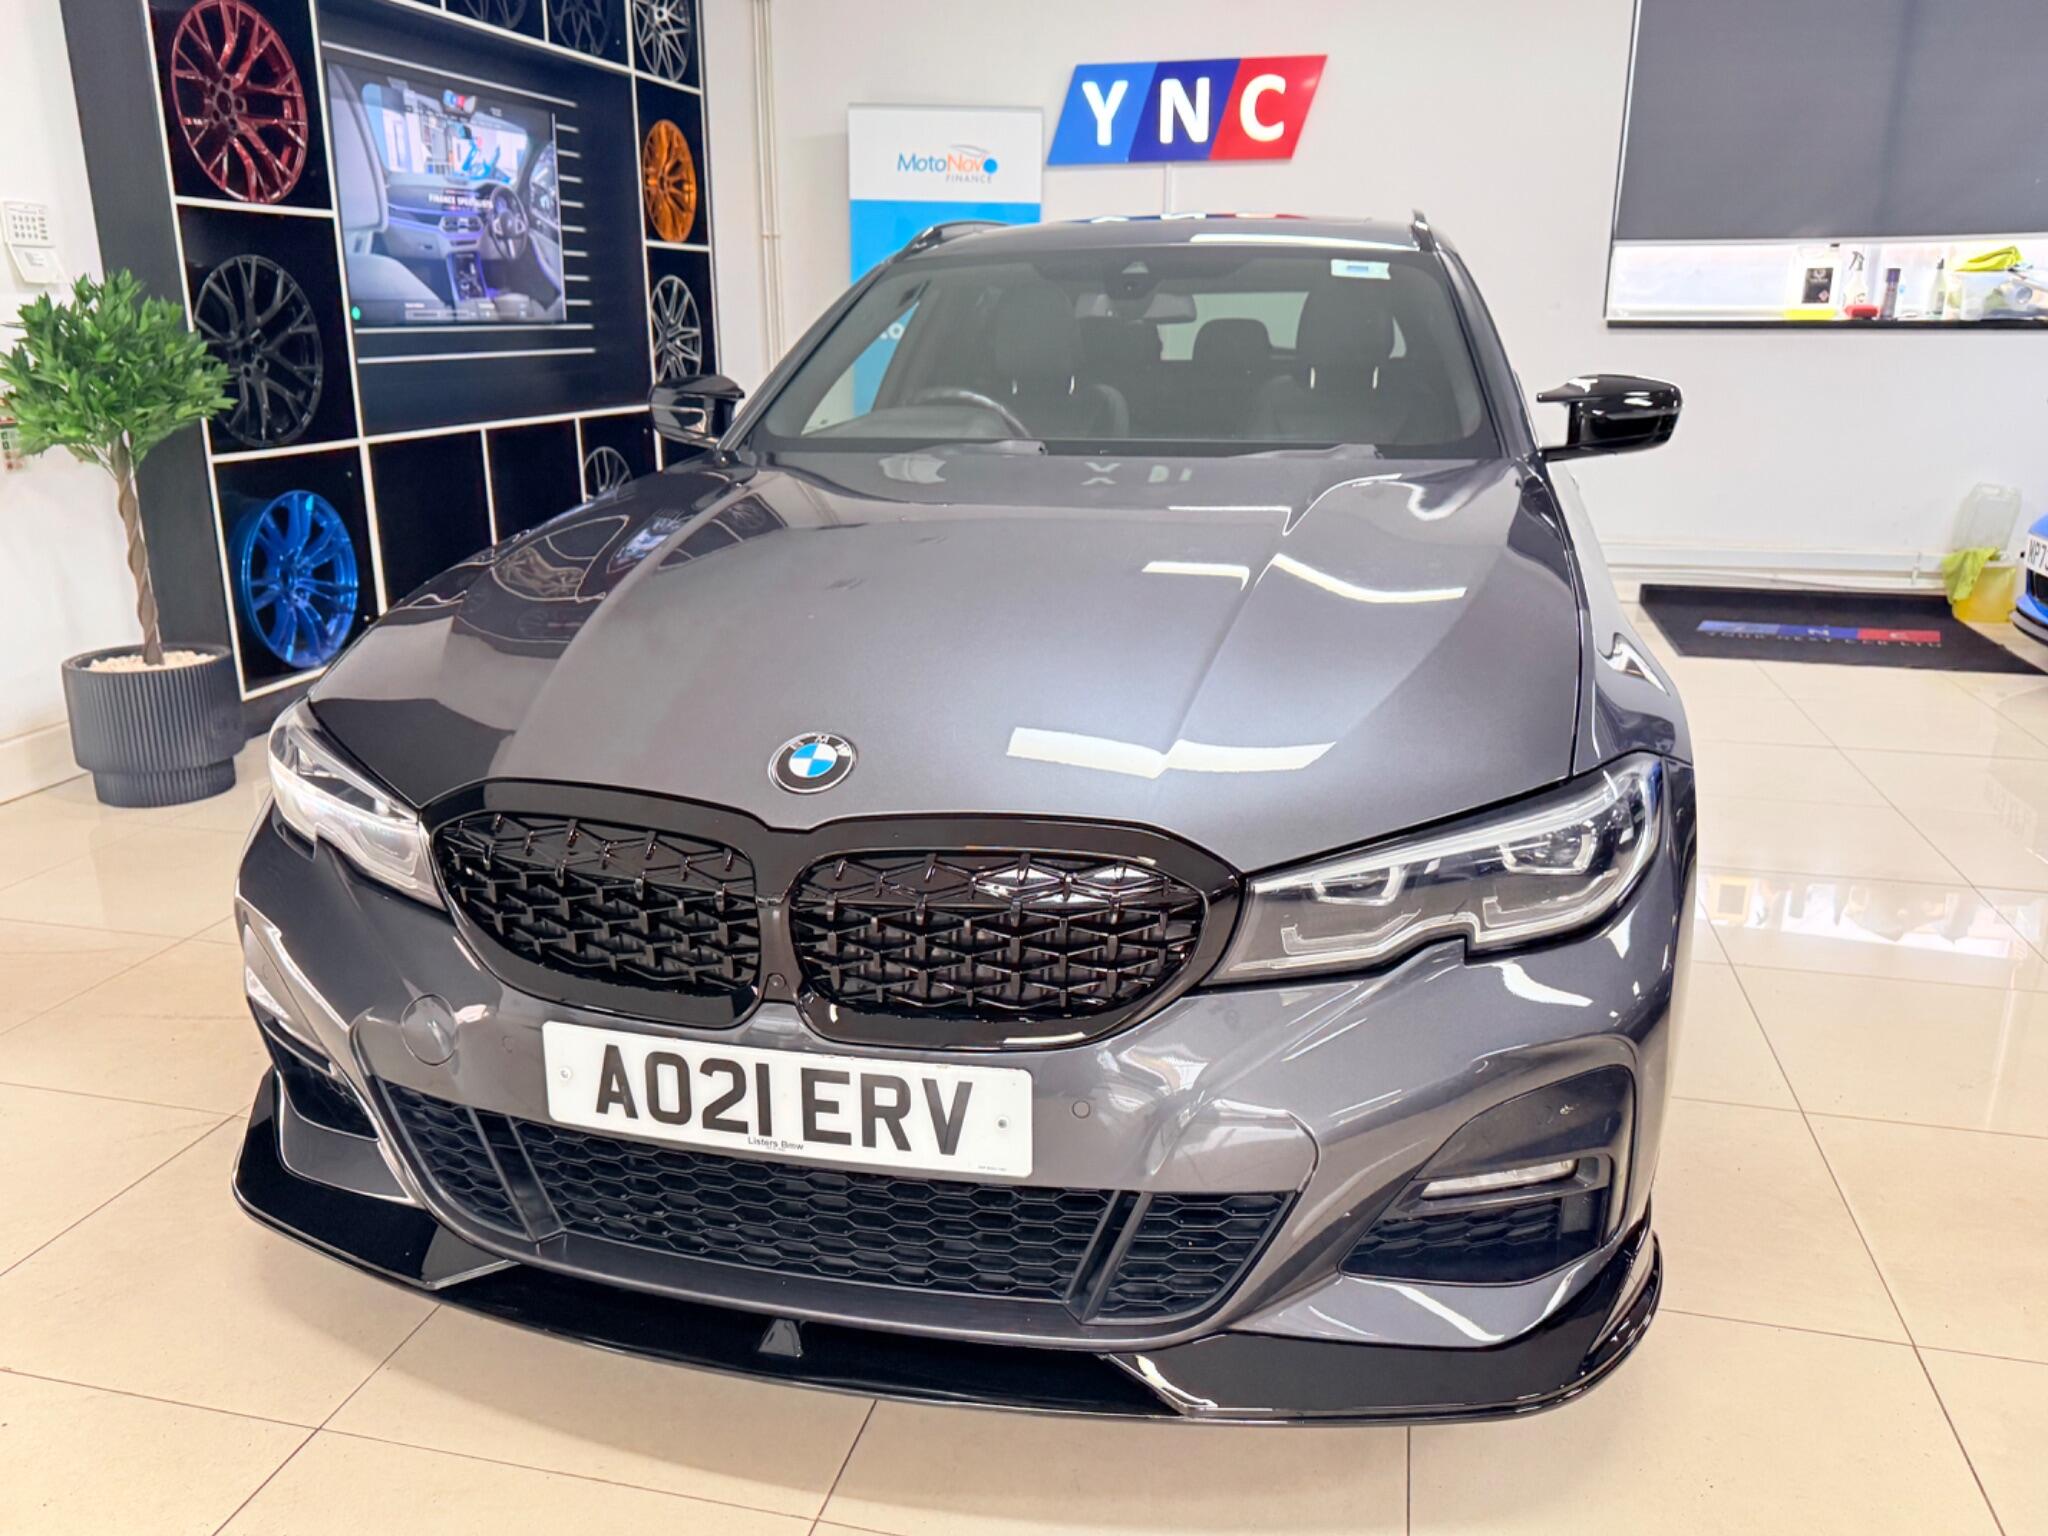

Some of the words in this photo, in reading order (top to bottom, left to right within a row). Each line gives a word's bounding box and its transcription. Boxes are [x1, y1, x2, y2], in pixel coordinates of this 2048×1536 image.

[1082, 73, 1287, 146] YNC
[945, 175, 992, 184] FINANCE
[800, 1067, 973, 1155] ERV
